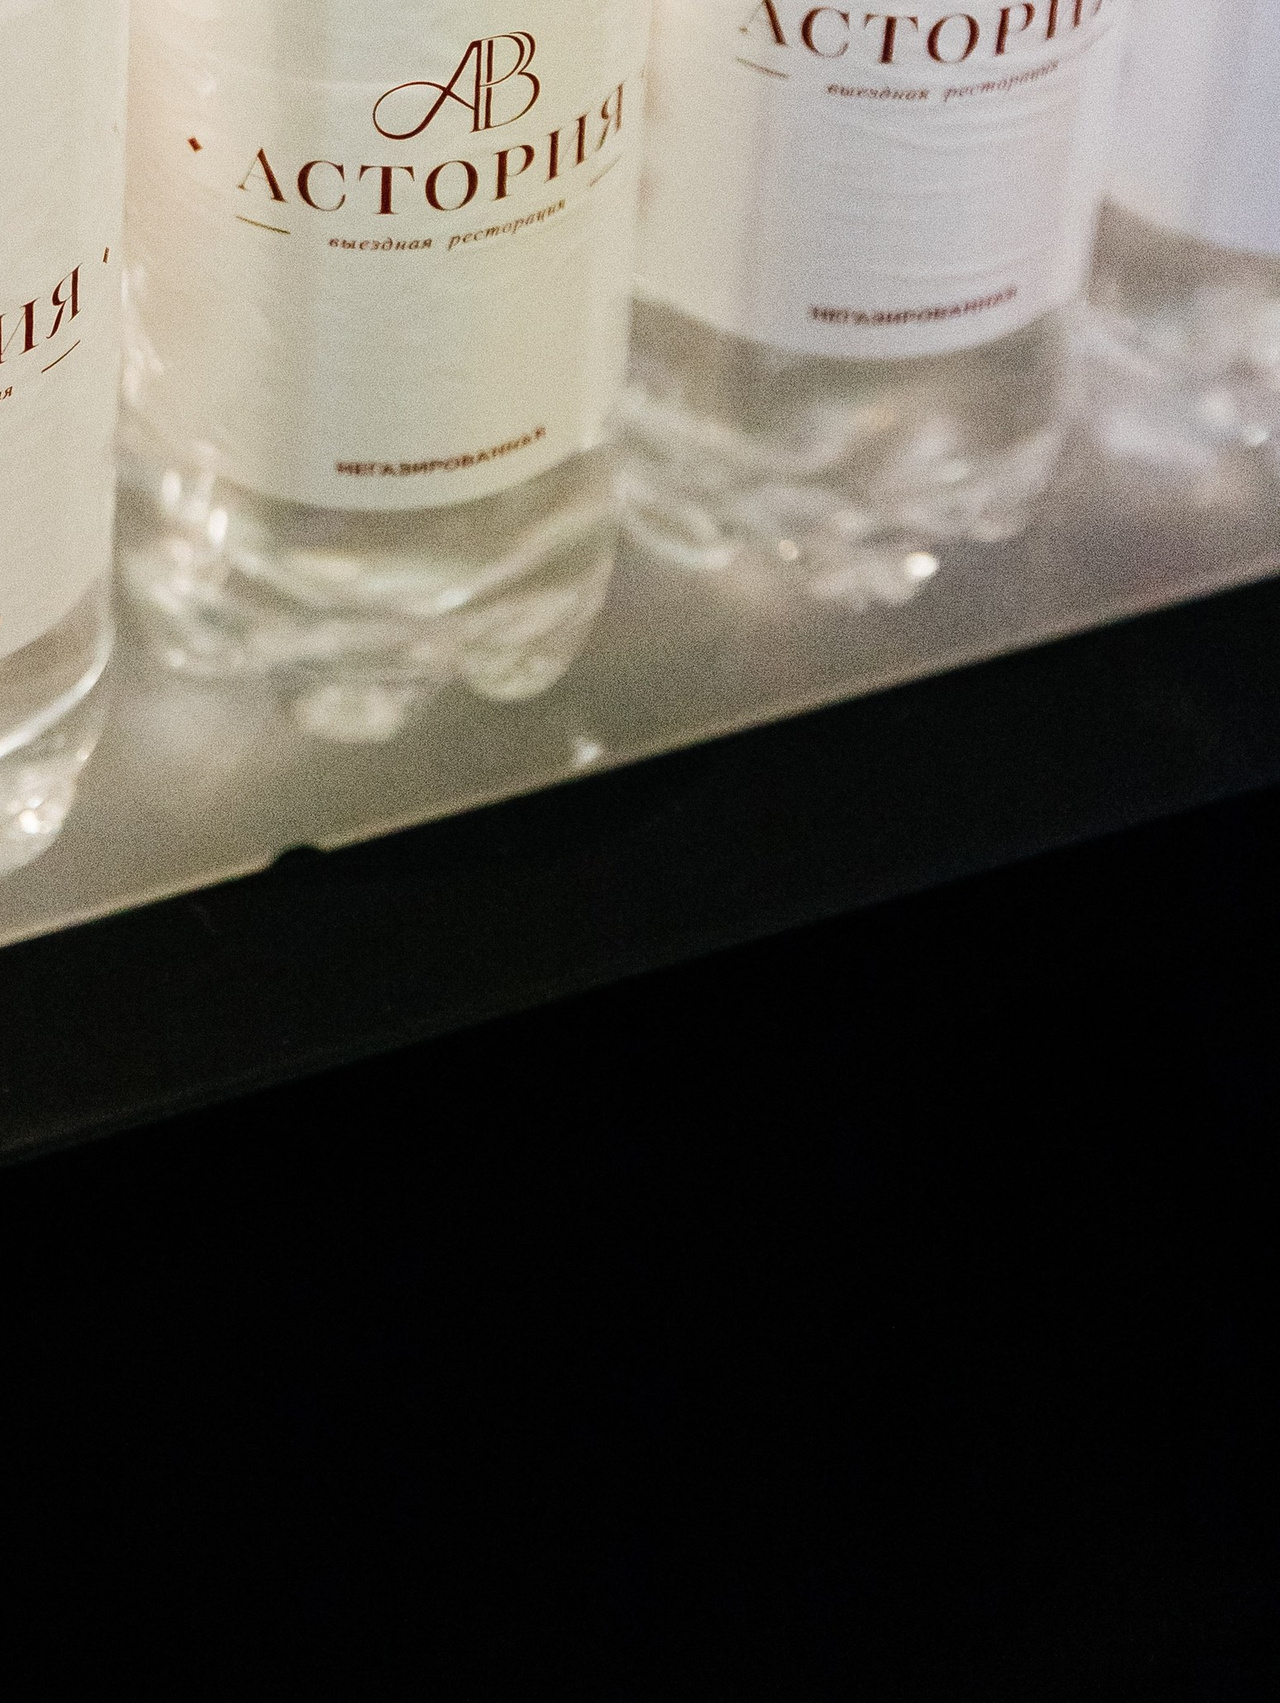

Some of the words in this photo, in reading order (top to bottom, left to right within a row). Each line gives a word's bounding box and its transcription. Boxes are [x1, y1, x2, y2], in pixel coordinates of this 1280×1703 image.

[236, 82, 625, 215] АСТОРИЯ
[327, 236, 433, 252] выездная
[446, 199, 566, 252] ресторация
